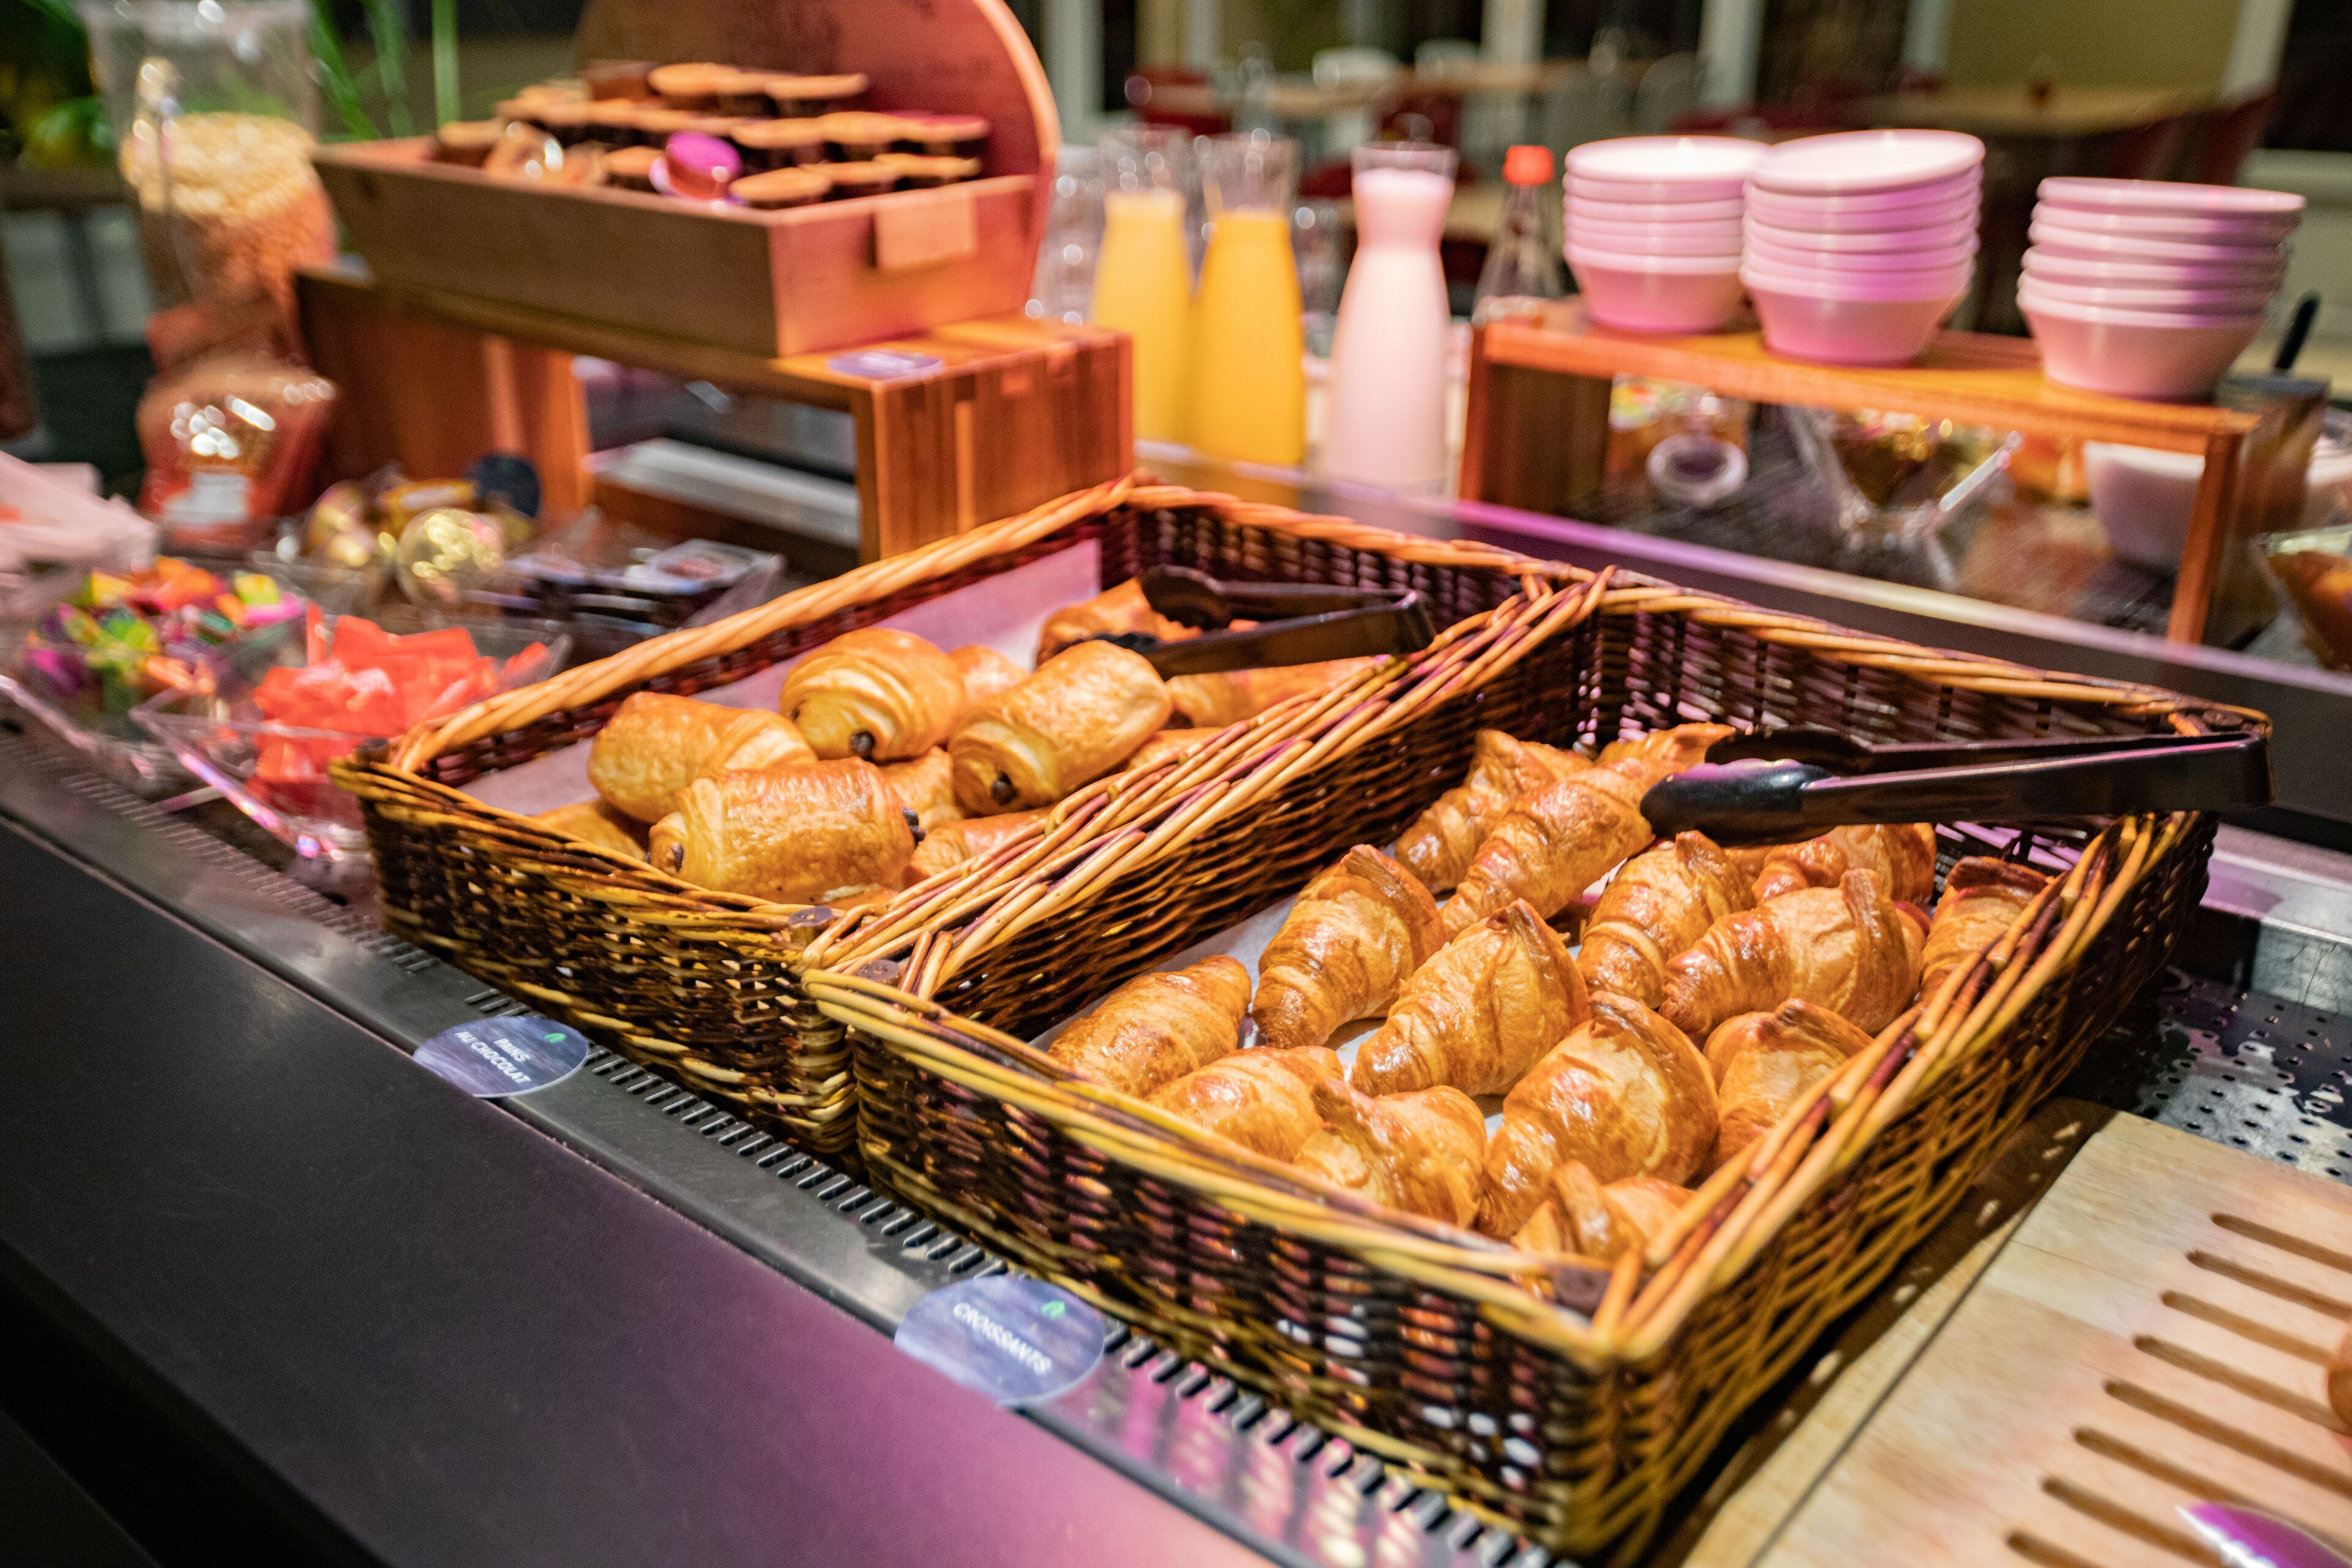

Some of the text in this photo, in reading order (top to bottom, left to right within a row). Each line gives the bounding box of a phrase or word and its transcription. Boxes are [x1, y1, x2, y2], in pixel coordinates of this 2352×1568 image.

[454, 1031, 532, 1084] AU CHOCOLAT
[493, 1038, 532, 1063] PAINS
[953, 1303, 1052, 1376] CROISSANTS
